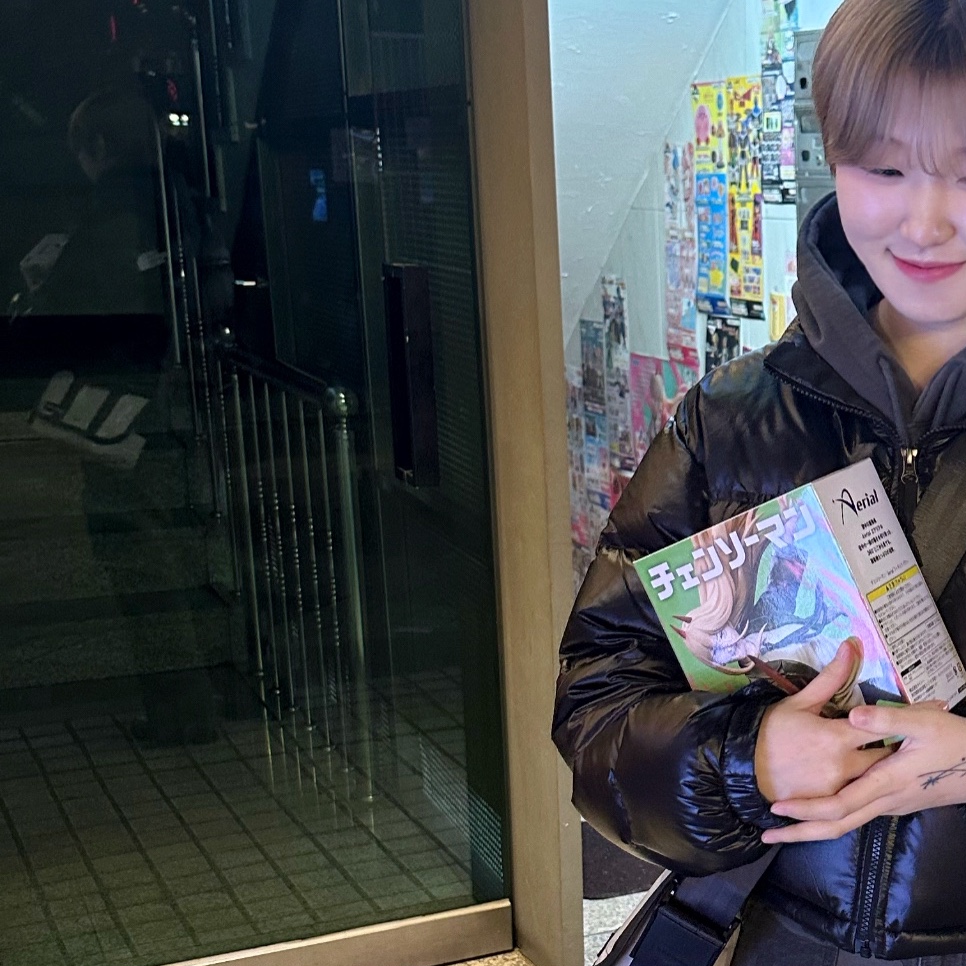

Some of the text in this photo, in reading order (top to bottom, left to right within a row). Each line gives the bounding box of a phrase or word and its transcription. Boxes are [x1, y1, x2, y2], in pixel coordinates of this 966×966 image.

[832, 488, 879, 525] Aerial
[648, 504, 816, 601] チェンソーマン
